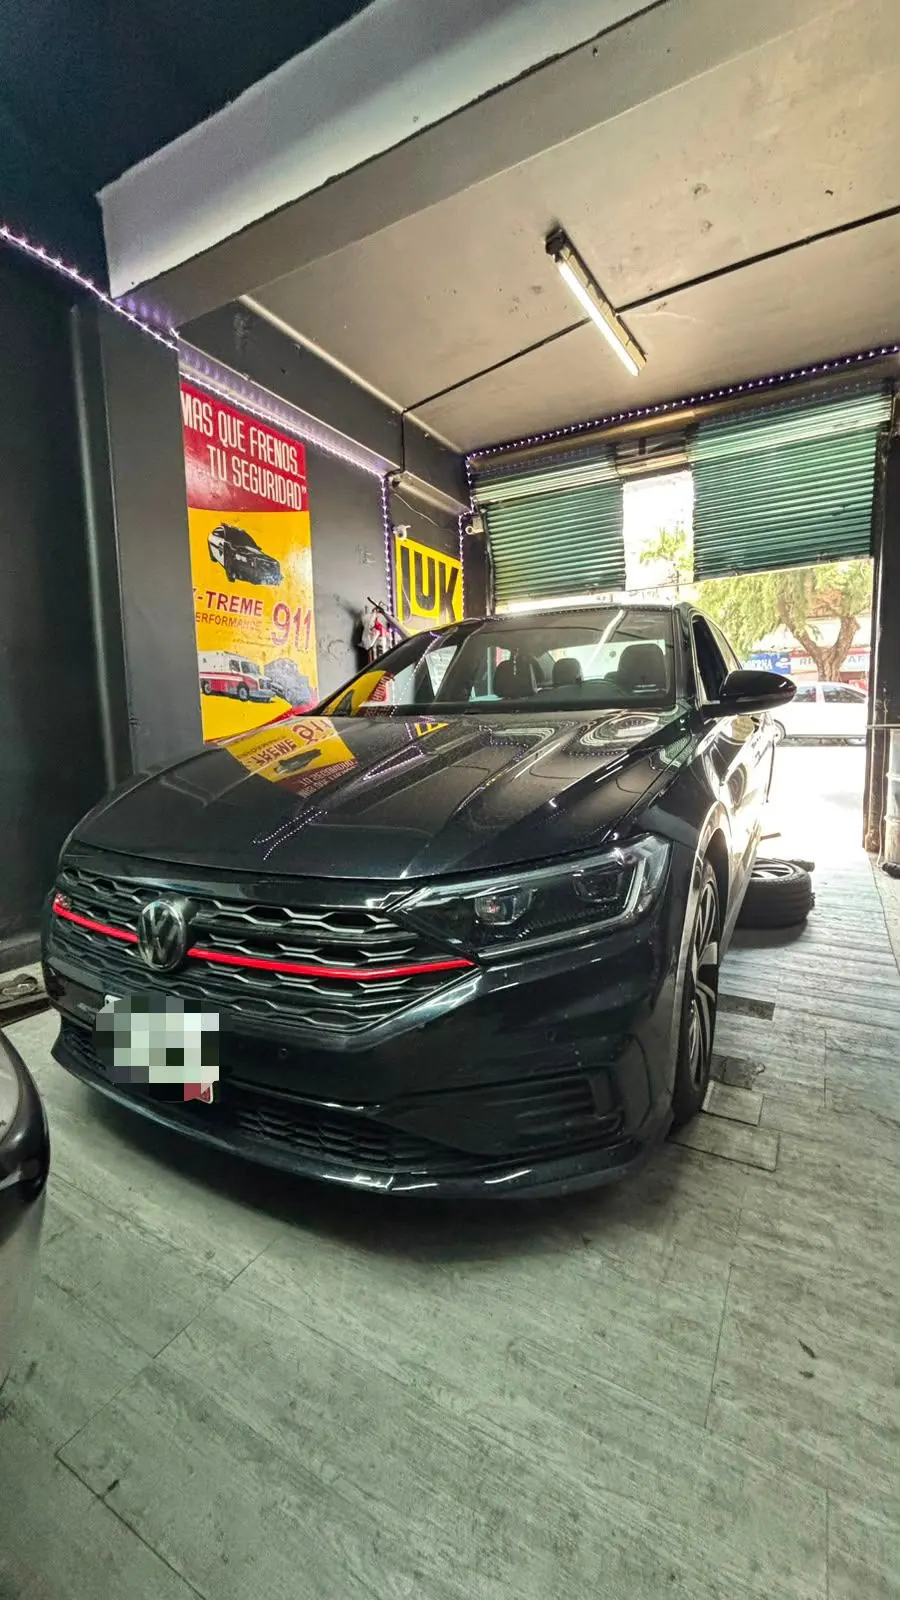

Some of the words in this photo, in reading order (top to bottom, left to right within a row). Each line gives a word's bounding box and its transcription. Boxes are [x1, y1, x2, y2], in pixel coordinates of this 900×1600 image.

[217, 410, 246, 453] QUE
[206, 445, 227, 482] TU
[270, 602, 312, 652] 911
